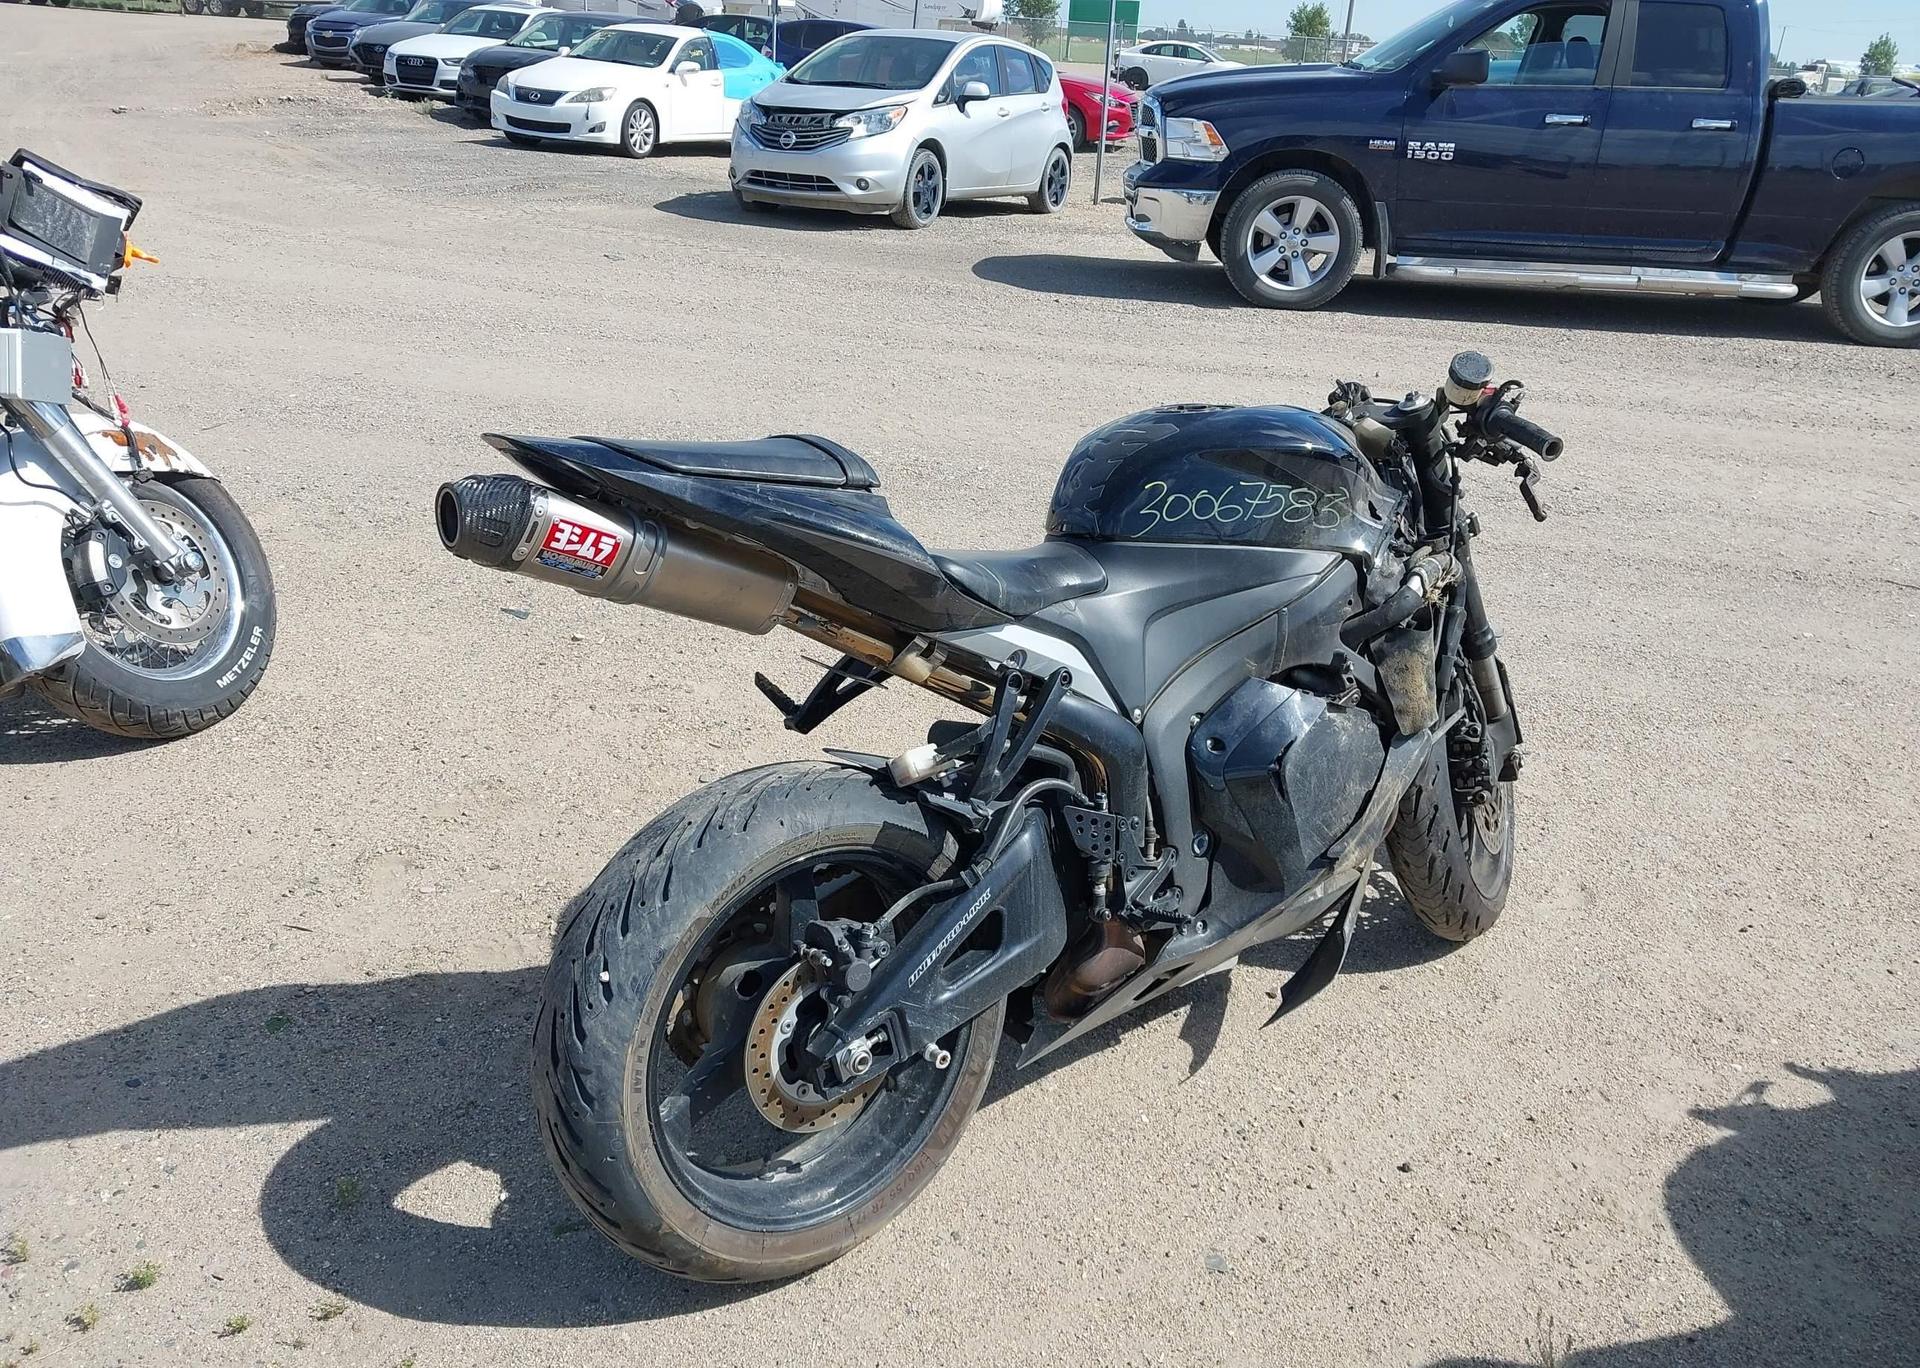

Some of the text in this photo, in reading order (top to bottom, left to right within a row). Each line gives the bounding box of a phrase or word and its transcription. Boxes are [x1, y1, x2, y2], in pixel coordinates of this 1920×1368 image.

[1407, 141, 1455, 151] RAM
[1407, 150, 1454, 160] 1500
[1130, 481, 1350, 538] 30067583
[549, 521, 616, 563] ヨシムラ
[216, 625, 263, 689] METZELER
[711, 874, 746, 910] ROAD
[908, 951, 936, 989] UNIT
